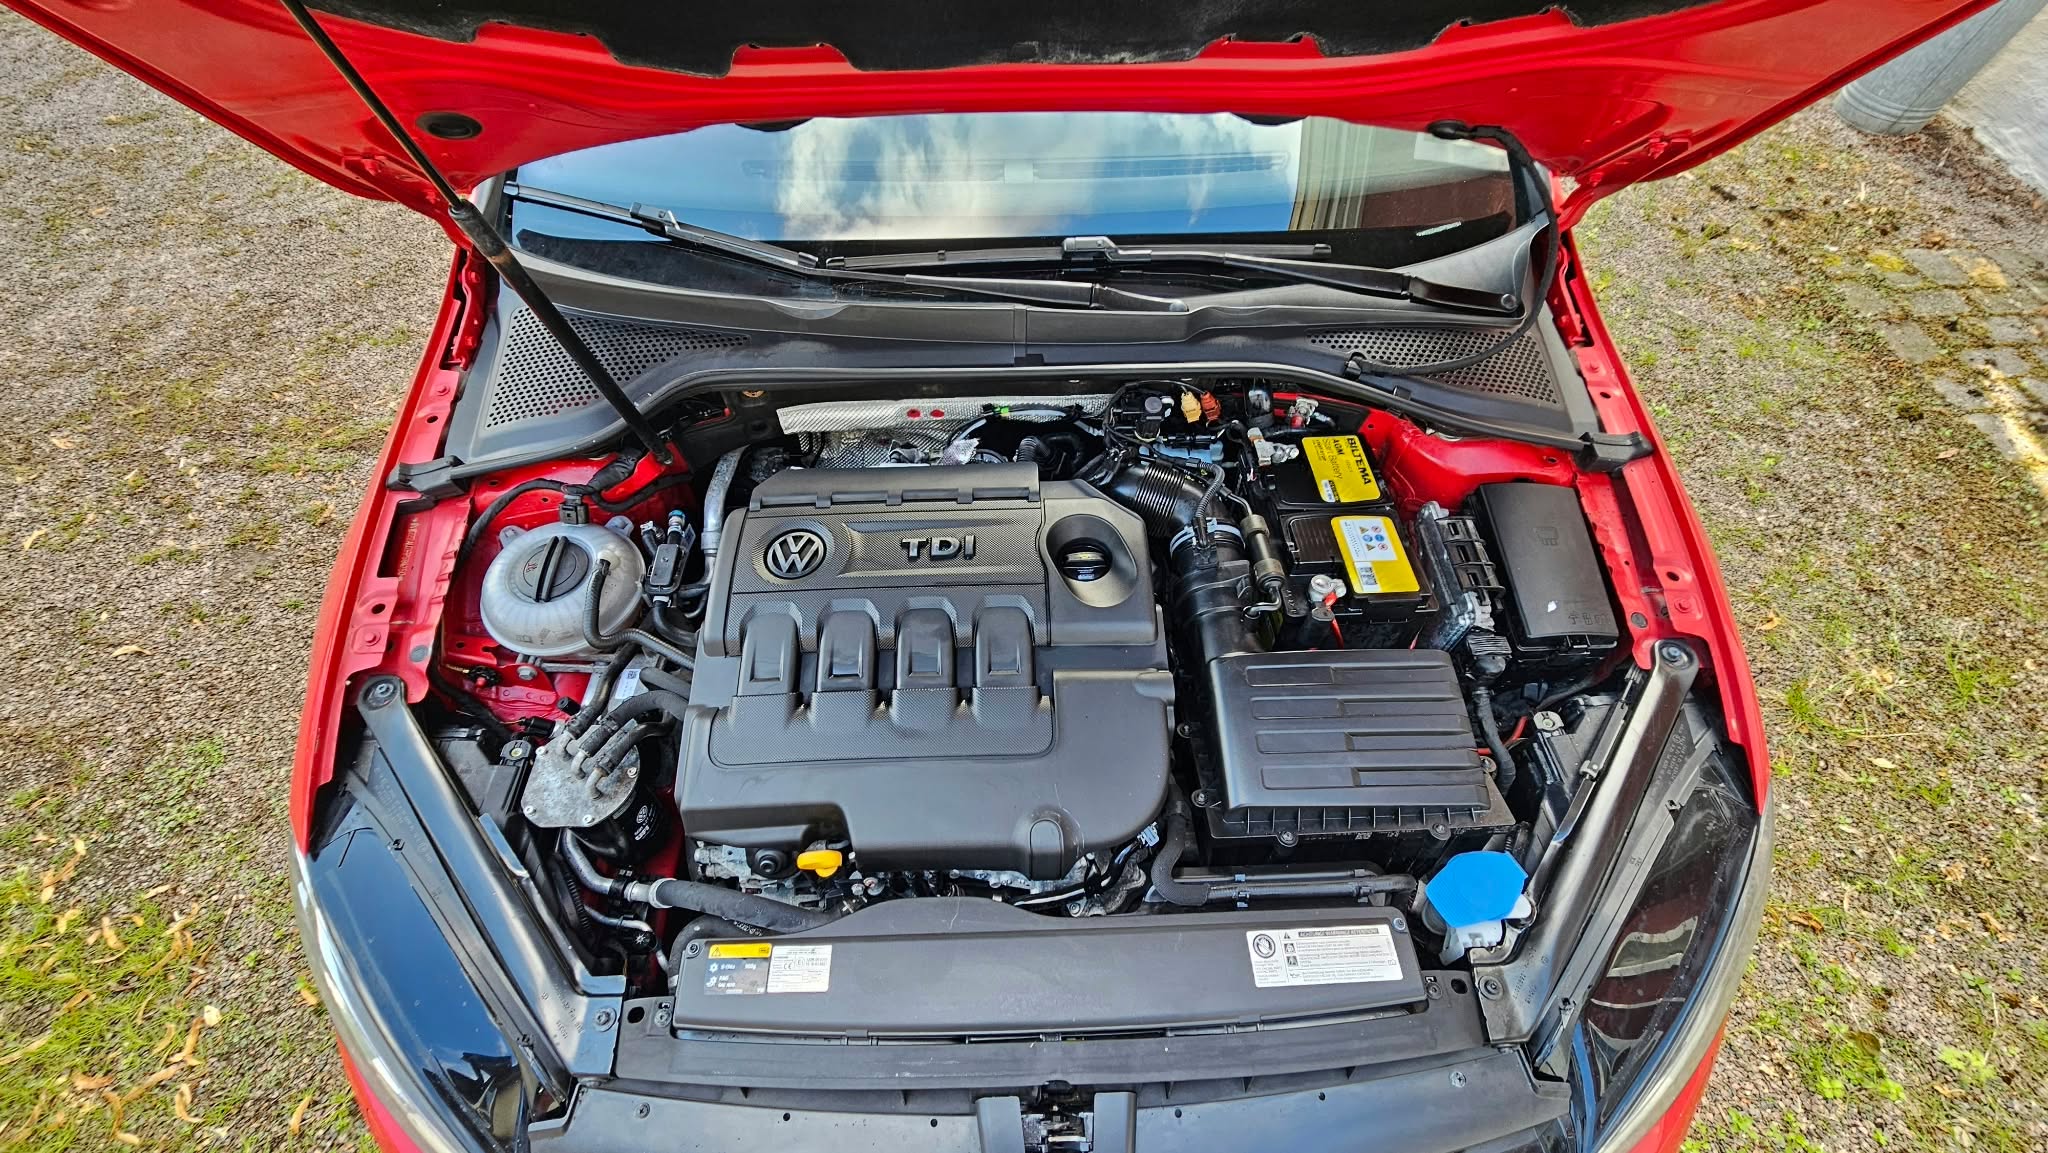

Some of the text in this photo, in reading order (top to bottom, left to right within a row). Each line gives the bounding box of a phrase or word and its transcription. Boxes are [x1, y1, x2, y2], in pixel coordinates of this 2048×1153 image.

[1327, 452, 1343, 480] Battery
[1347, 437, 1371, 484] BILTEMA
[766, 531, 825, 578] VW
[901, 535, 976, 560] TDI
